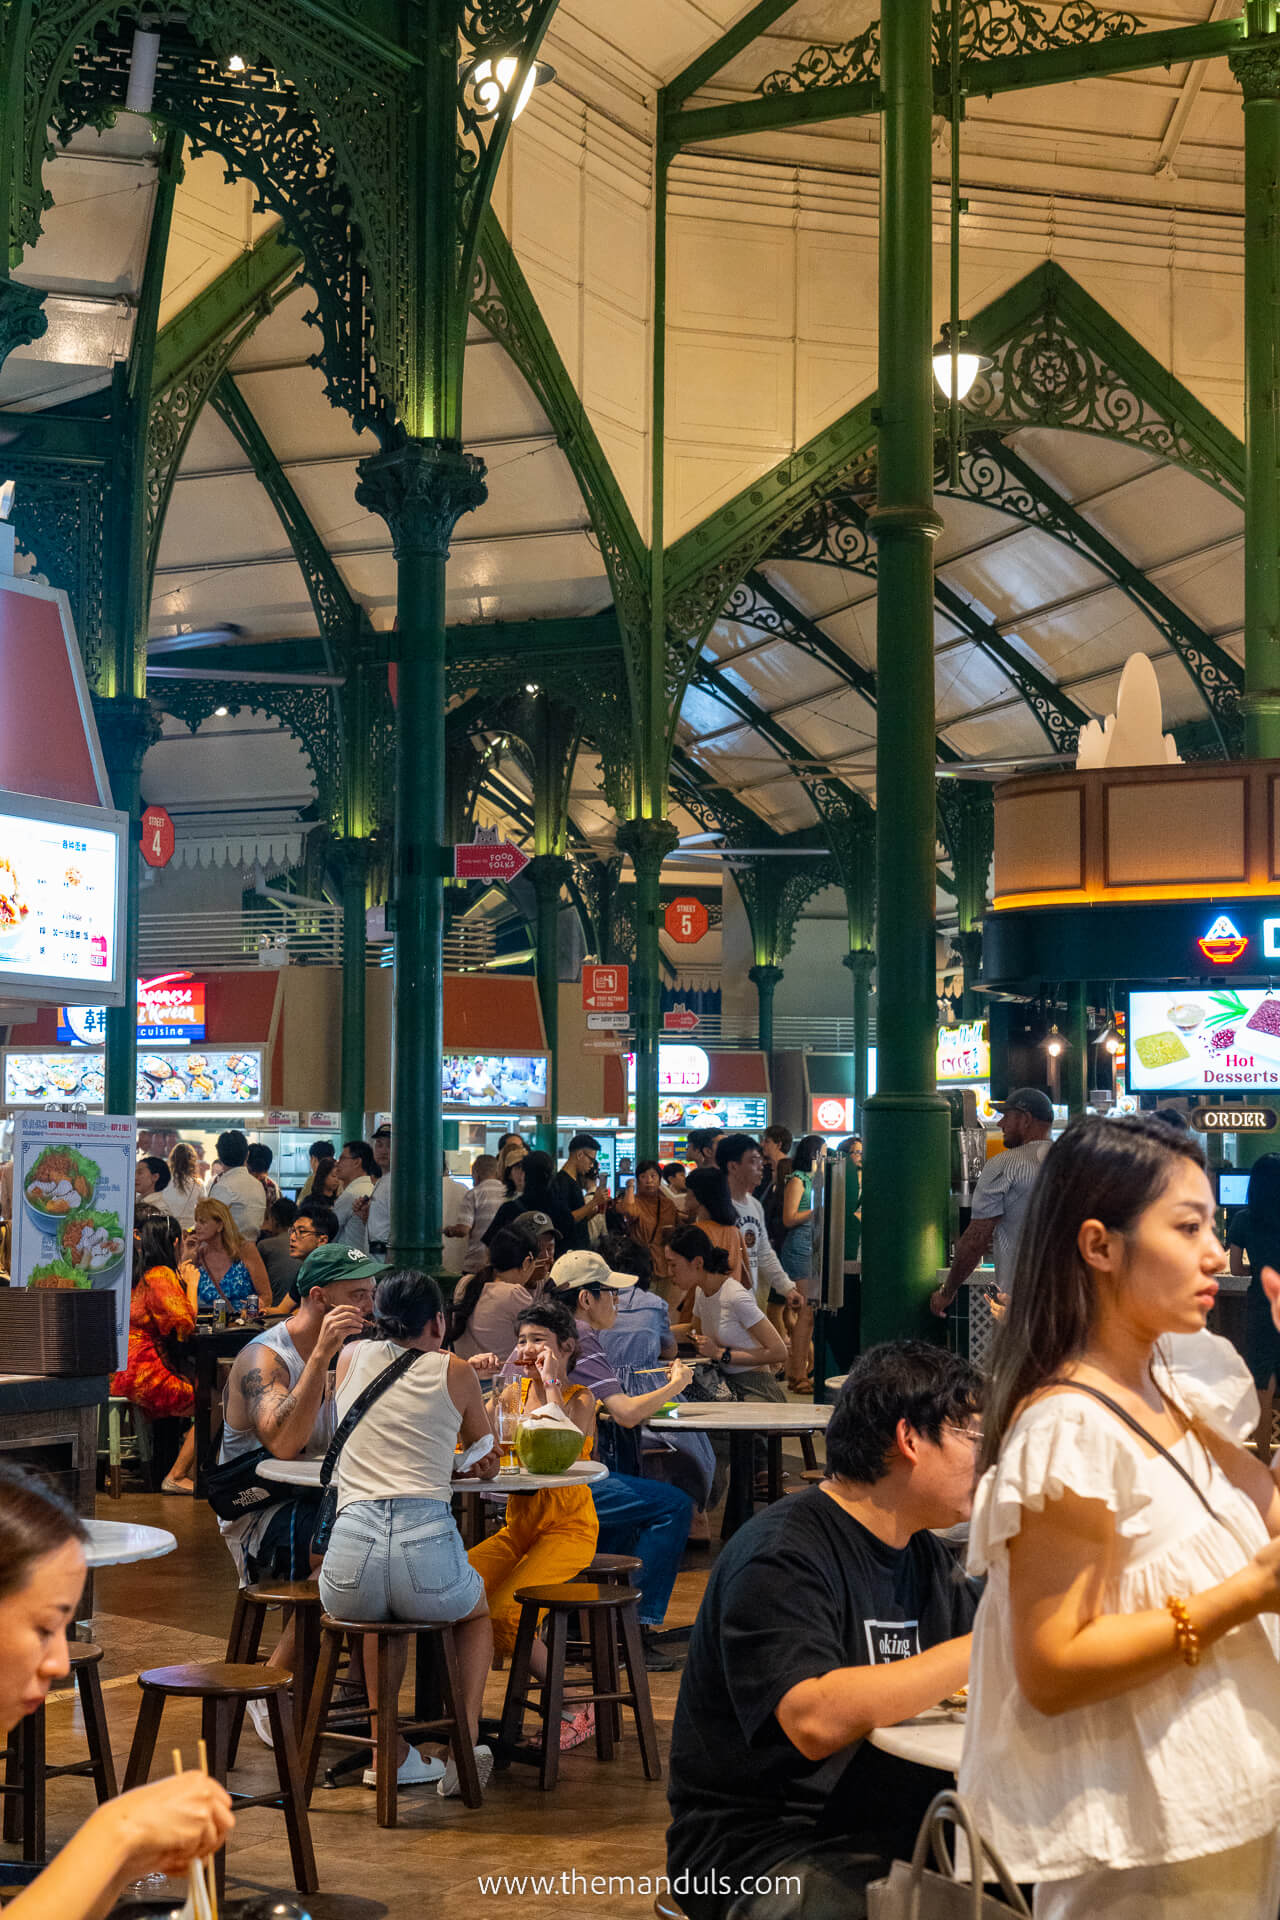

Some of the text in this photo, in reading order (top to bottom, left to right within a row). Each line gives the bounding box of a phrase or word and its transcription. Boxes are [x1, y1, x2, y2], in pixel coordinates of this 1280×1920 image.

[149, 816, 165, 827] STREET
[152, 830, 161, 856] 4
[490, 853, 513, 862] FOOD
[682, 915, 691, 935] 5
[140, 1027, 184, 1036] cuisine
[1226, 1054, 1254, 1067] Hot
[1204, 1070, 1278, 1083] Desserts
[1205, 1112, 1267, 1127] ORDER
